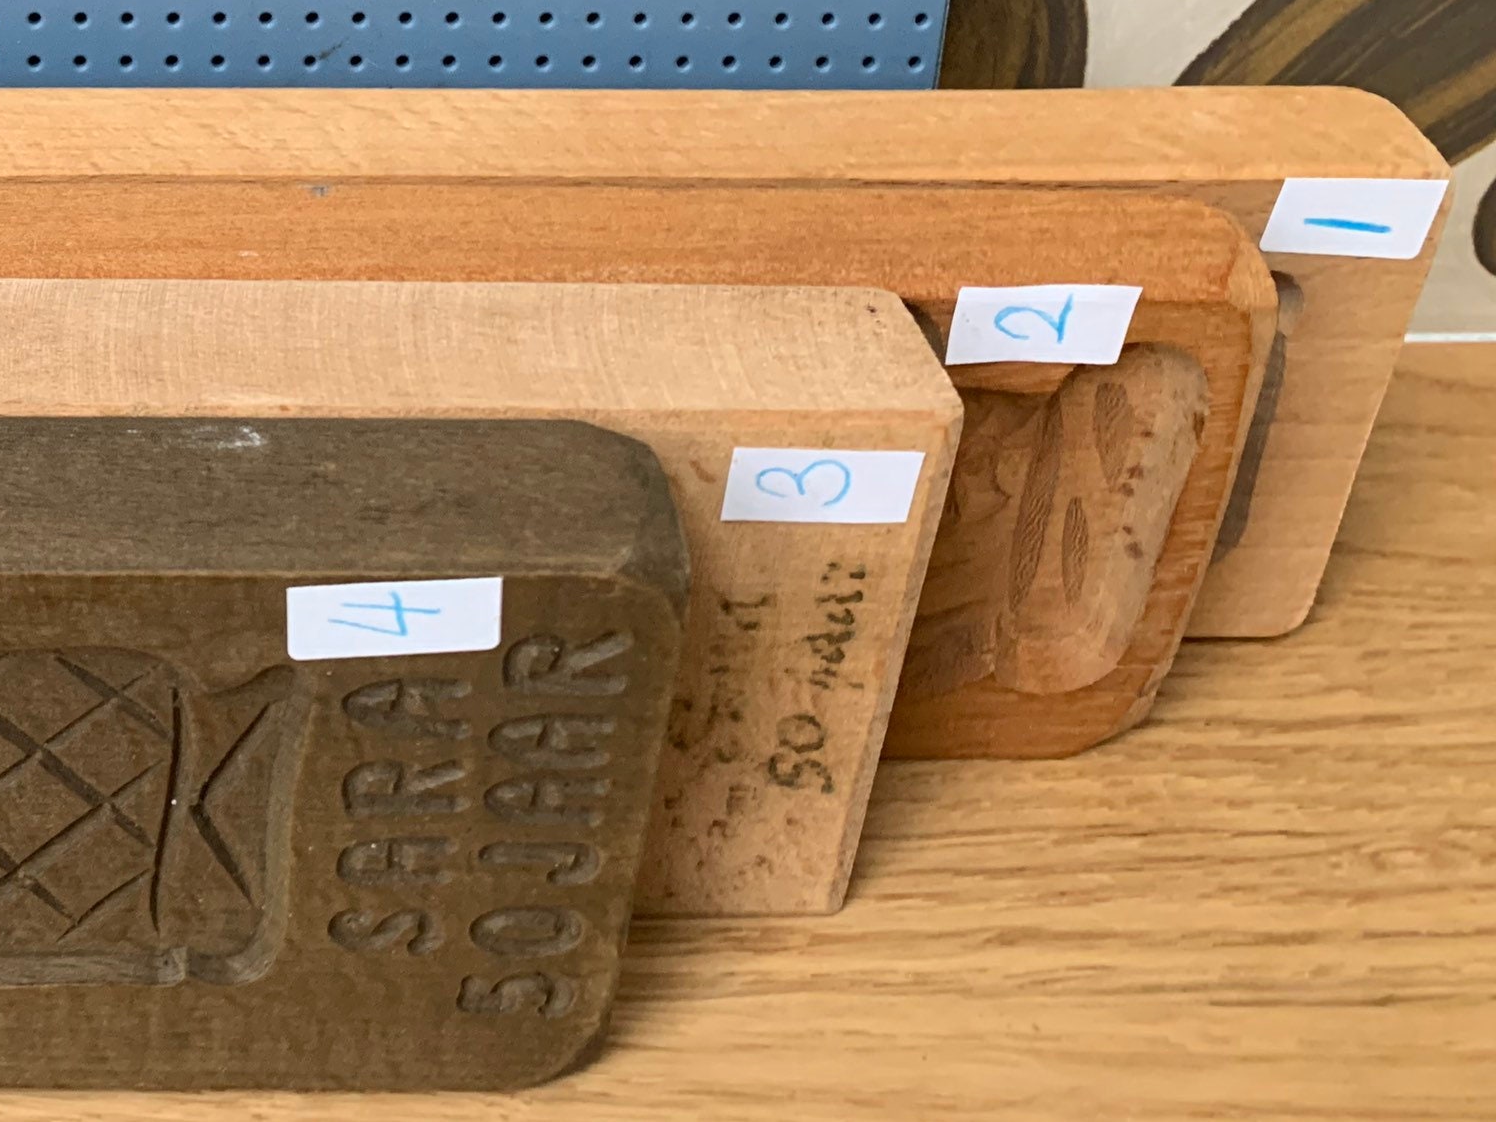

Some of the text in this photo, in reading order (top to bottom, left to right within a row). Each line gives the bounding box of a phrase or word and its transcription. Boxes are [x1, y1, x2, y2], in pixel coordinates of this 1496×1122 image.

[1303, 216, 1392, 234] 1
[994, 293, 1073, 343] 2
[755, 459, 851, 507] 3
[328, 590, 441, 636] 4
[327, 677, 473, 956] SARA
